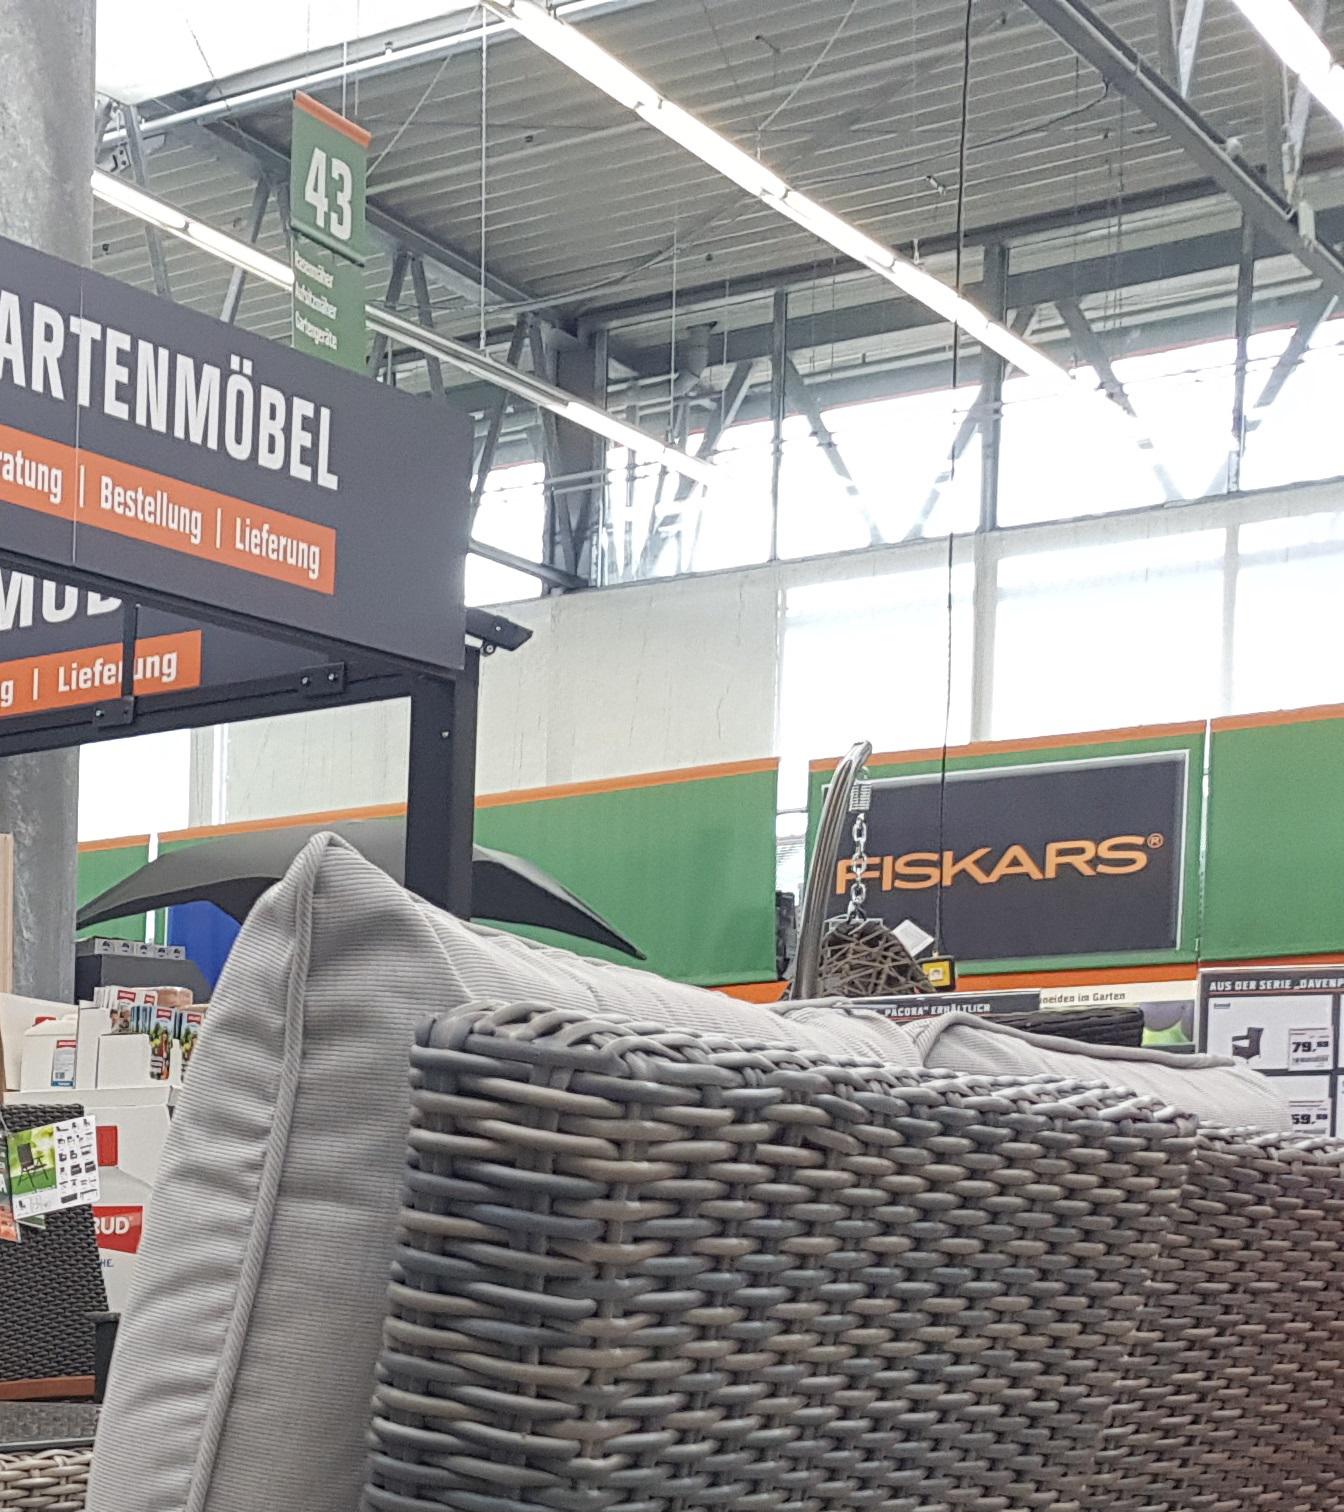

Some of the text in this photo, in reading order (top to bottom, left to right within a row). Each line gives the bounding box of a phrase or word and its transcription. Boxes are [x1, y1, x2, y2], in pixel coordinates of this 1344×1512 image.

[305, 147, 352, 241] 43
[100, 475, 202, 545] Bestellung
[235, 517, 321, 580] Lieferung
[1041, 994, 1075, 1004] neiden
[1093, 992, 1126, 1001] Garten
[1209, 980, 1231, 991] AUS
[1260, 979, 1292, 989] SERIE
